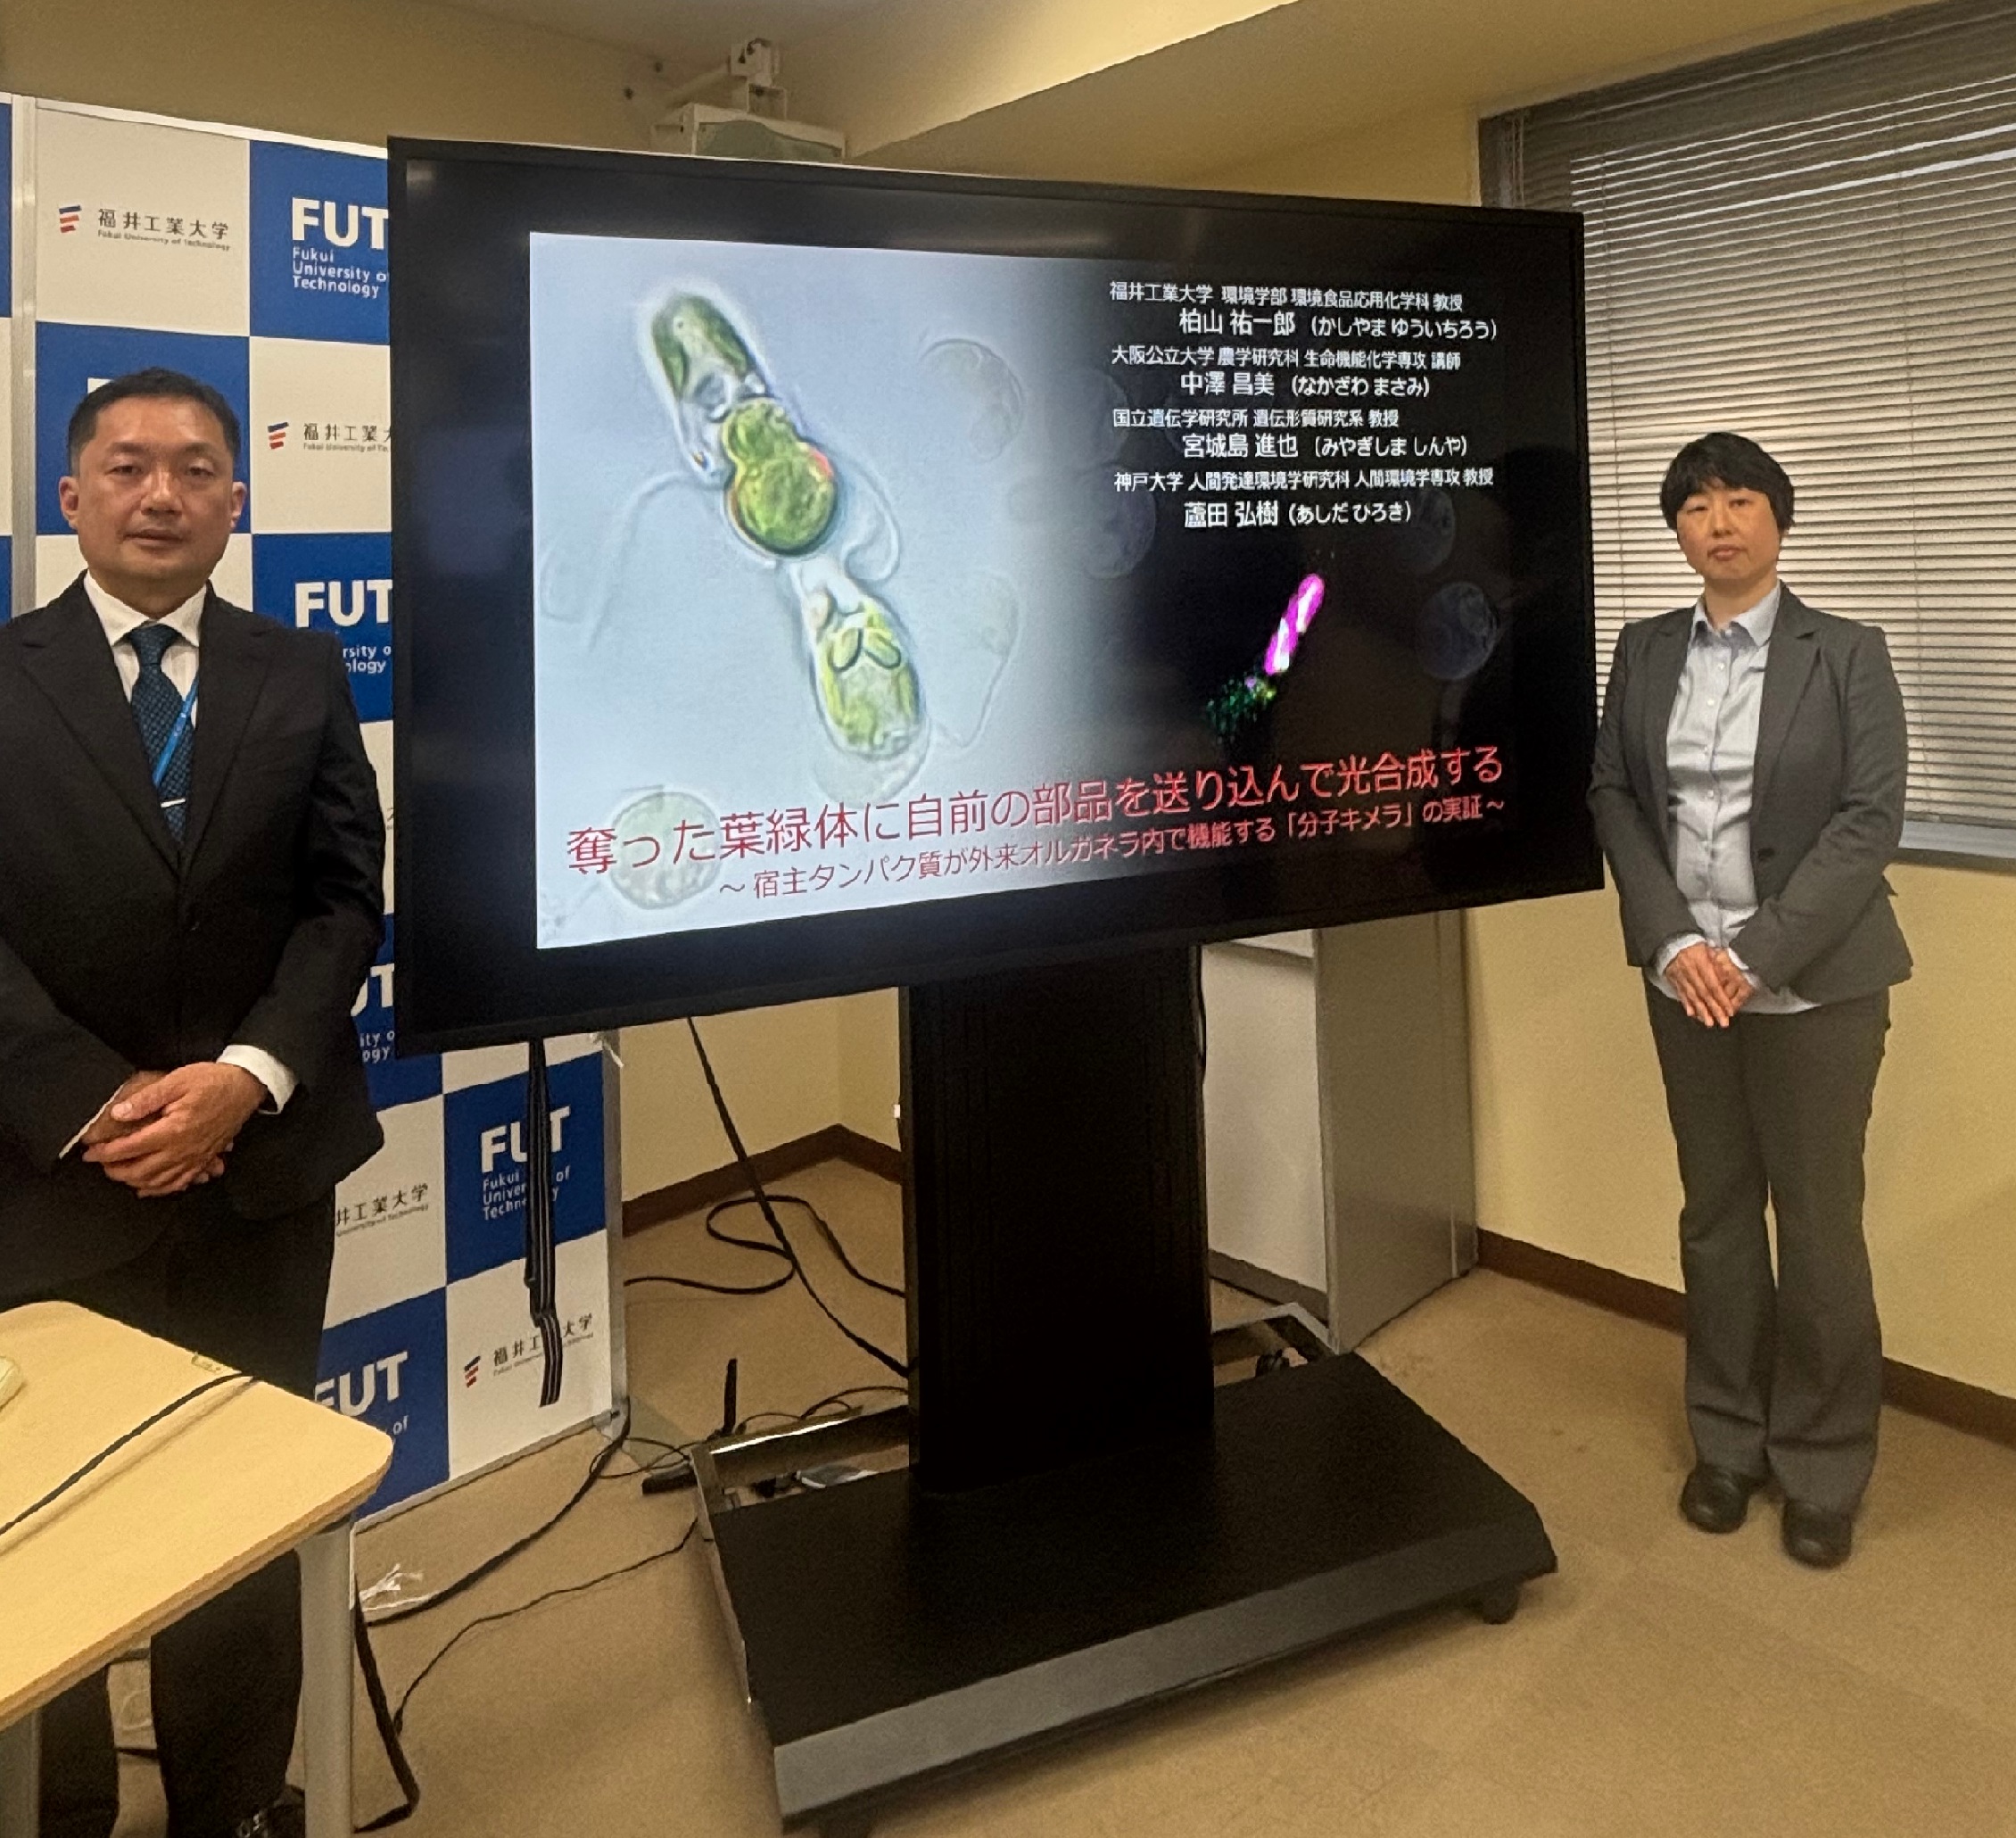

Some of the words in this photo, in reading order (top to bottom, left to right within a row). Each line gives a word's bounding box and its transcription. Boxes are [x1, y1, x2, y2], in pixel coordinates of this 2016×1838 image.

[98, 208, 228, 240] 福井工業大学
[292, 196, 389, 250] FUT
[293, 246, 335, 263] Fukui
[293, 260, 370, 284] University
[293, 274, 379, 300] Technology
[1110, 281, 1214, 304] 福井工業大学
[1221, 286, 1288, 307] 環境学部
[1290, 287, 1430, 311] 環境食品応用化学科
[1433, 293, 1463, 312] 教授
[1178, 307, 1223, 335] 柏山
[1229, 308, 1296, 336] 祐一郎
[1111, 344, 1215, 367] 大阪公立大学
[1217, 345, 1299, 368] 農学研究科
[1303, 347, 1427, 371] 生命機能化学専攻
[1431, 351, 1462, 371] 講師
[1180, 370, 1226, 396] 中澤
[1233, 371, 1275, 396] 昌美
[1113, 408, 1249, 428] 国立遺伝学研究所
[1252, 408, 1365, 428] 遺伝形質研究系
[1367, 408, 1400, 428] 教授
[1182, 432, 1249, 459] 宮城島
[1254, 432, 1299, 459] 進也
[1113, 470, 1185, 493] 神戸大学
[1187, 469, 1351, 492] 人間発達環境学研究科
[1353, 467, 1461, 489] 人間環境学専攻
[1462, 466, 1494, 487] 教授
[1234, 500, 1279, 527] 弘樹
[294, 579, 392, 628] FUT
[343, 644, 376, 660] rsity
[566, 745, 1503, 876] 奪った葉緑体に自前の部品を送り込んで光合成する
[483, 1169, 520, 1192] Fukui
[483, 1181, 526, 1205] Univer
[556, 1165, 571, 1182] of
[335, 1182, 428, 1227] 井工業大学
[493, 1312, 592, 1367] 福井工大学
